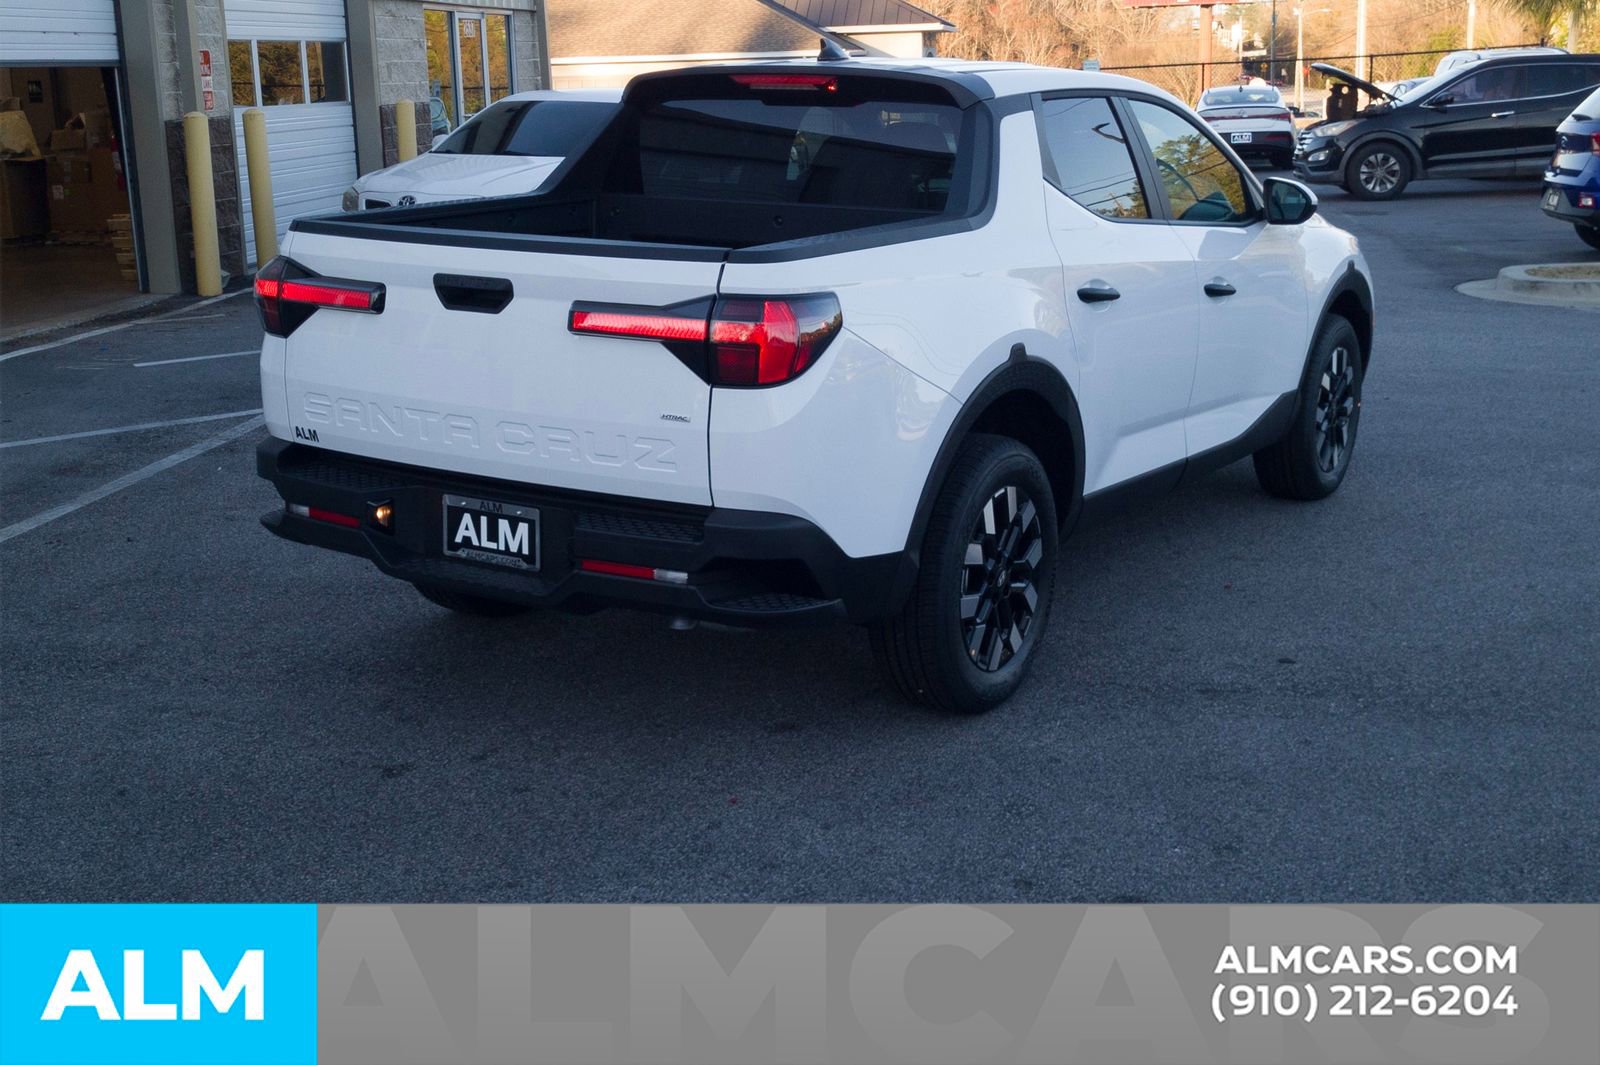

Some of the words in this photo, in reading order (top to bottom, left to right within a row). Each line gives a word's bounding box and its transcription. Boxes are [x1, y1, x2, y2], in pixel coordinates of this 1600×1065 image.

[295, 426, 319, 442] ALM
[304, 392, 479, 448] SANTA
[496, 420, 676, 472] CRUZ
[480, 501, 503, 513] ALM
[454, 512, 529, 555] ALM
